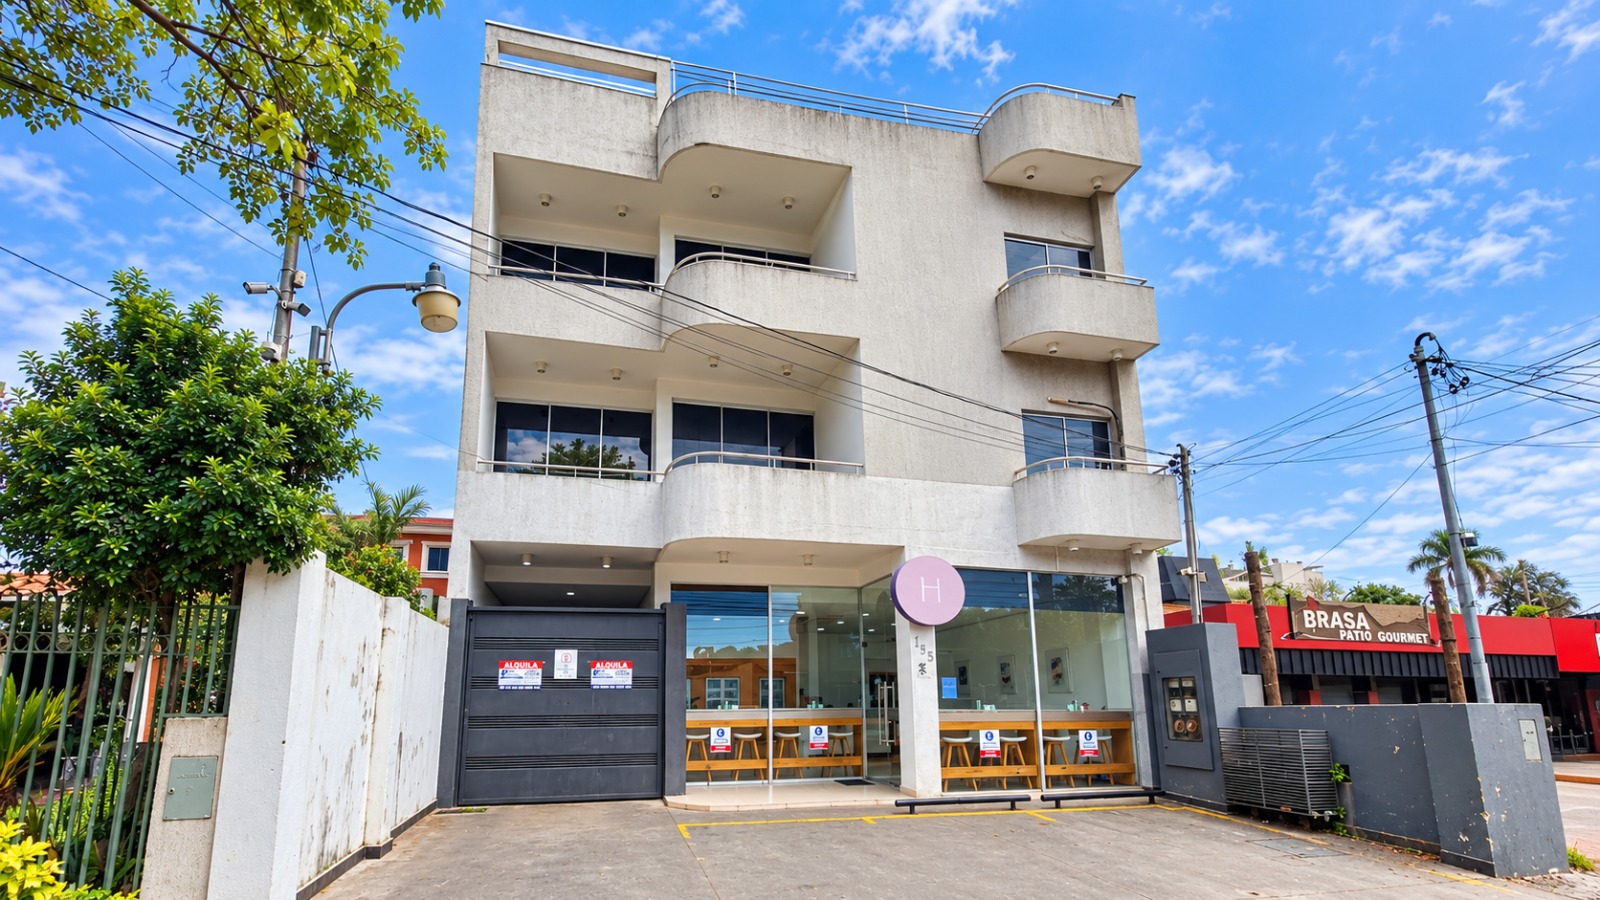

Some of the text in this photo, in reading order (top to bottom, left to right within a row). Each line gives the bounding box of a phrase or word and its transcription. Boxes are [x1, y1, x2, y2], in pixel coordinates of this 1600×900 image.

[921, 577, 941, 603] H
[1303, 609, 1370, 630] BRASA
[1340, 630, 1428, 644] PATIO GOURMET
